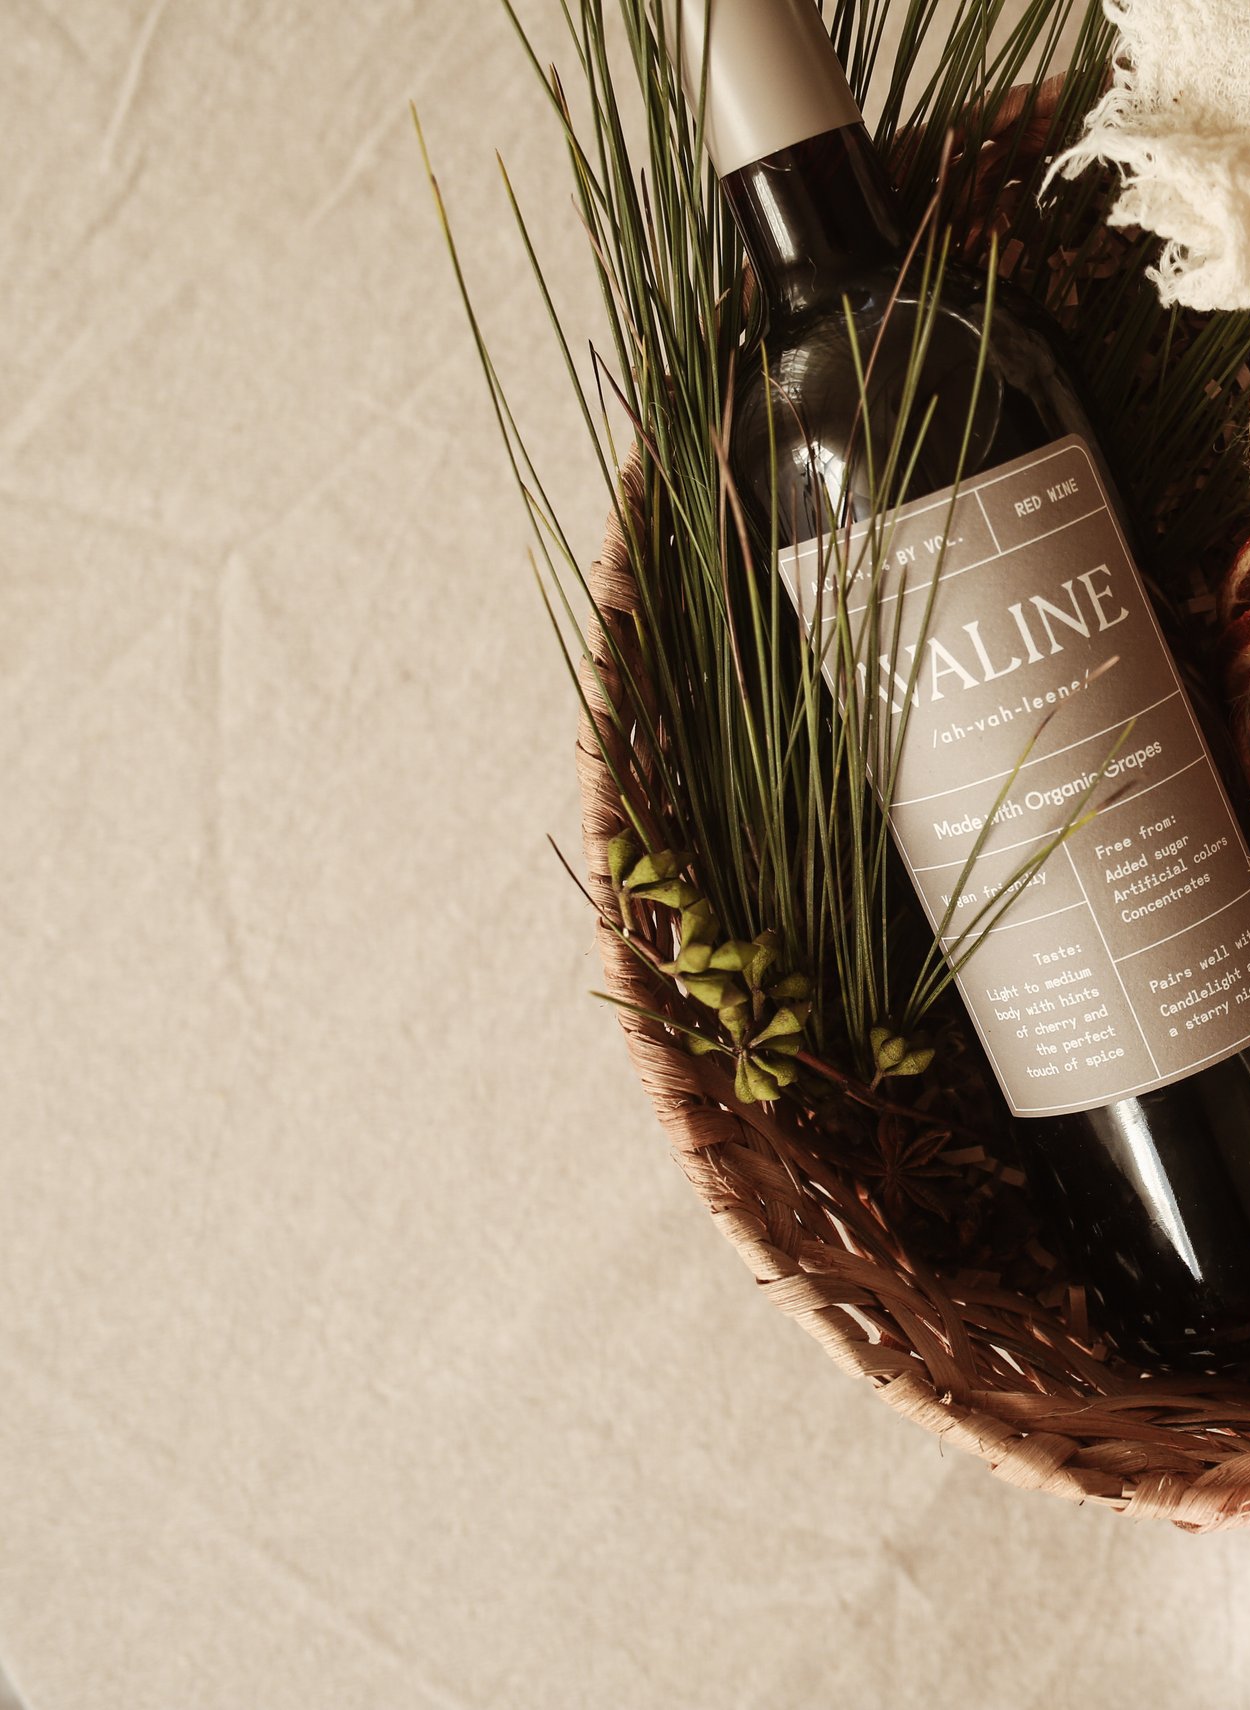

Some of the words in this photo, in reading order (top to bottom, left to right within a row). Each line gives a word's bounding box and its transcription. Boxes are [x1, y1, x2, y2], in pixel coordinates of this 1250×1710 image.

[1013, 495, 1041, 518] RED
[1047, 477, 1079, 503] WINE
[896, 546, 916, 566] BY
[932, 669, 1089, 749] /ah-vah-leene/
[933, 814, 983, 840] Made
[1025, 772, 1100, 810] Organic
[1103, 741, 1162, 778] Grapes
[1095, 838, 1132, 860] Free
[1139, 814, 1177, 840] from:
[1105, 853, 1148, 883] Added
[1154, 835, 1190, 860] sugar
[1113, 859, 1189, 904] Artificial
[1193, 836, 1228, 864] colors
[941, 893, 977, 908] Vgan
[1121, 873, 1211, 923] Concentrates
[1033, 944, 1082, 966] Taste:
[1149, 969, 1193, 993] Pairs
[1199, 945, 1230, 971] well
[986, 985, 1019, 1002] Light
[1024, 982, 1039, 995] to
[1044, 967, 1092, 990] medium
[994, 1007, 1021, 1021] body
[1026, 999, 1055, 1016] with
[1059, 987, 1100, 1007] hints
[1160, 969, 1242, 1018] Candlelight
[1016, 1025, 1029, 1039] of
[1034, 1017, 1077, 1036] cherry
[1084, 1004, 1109, 1023] and
[1169, 1027, 1179, 1038] a
[1185, 1000, 1230, 1030] starry
[1036, 1042, 1058, 1056] the
[1063, 1024, 1116, 1053] perfect
[1026, 1063, 1060, 1078] touch
[1064, 1058, 1078, 1072] of
[1085, 1047, 1125, 1067] spice
